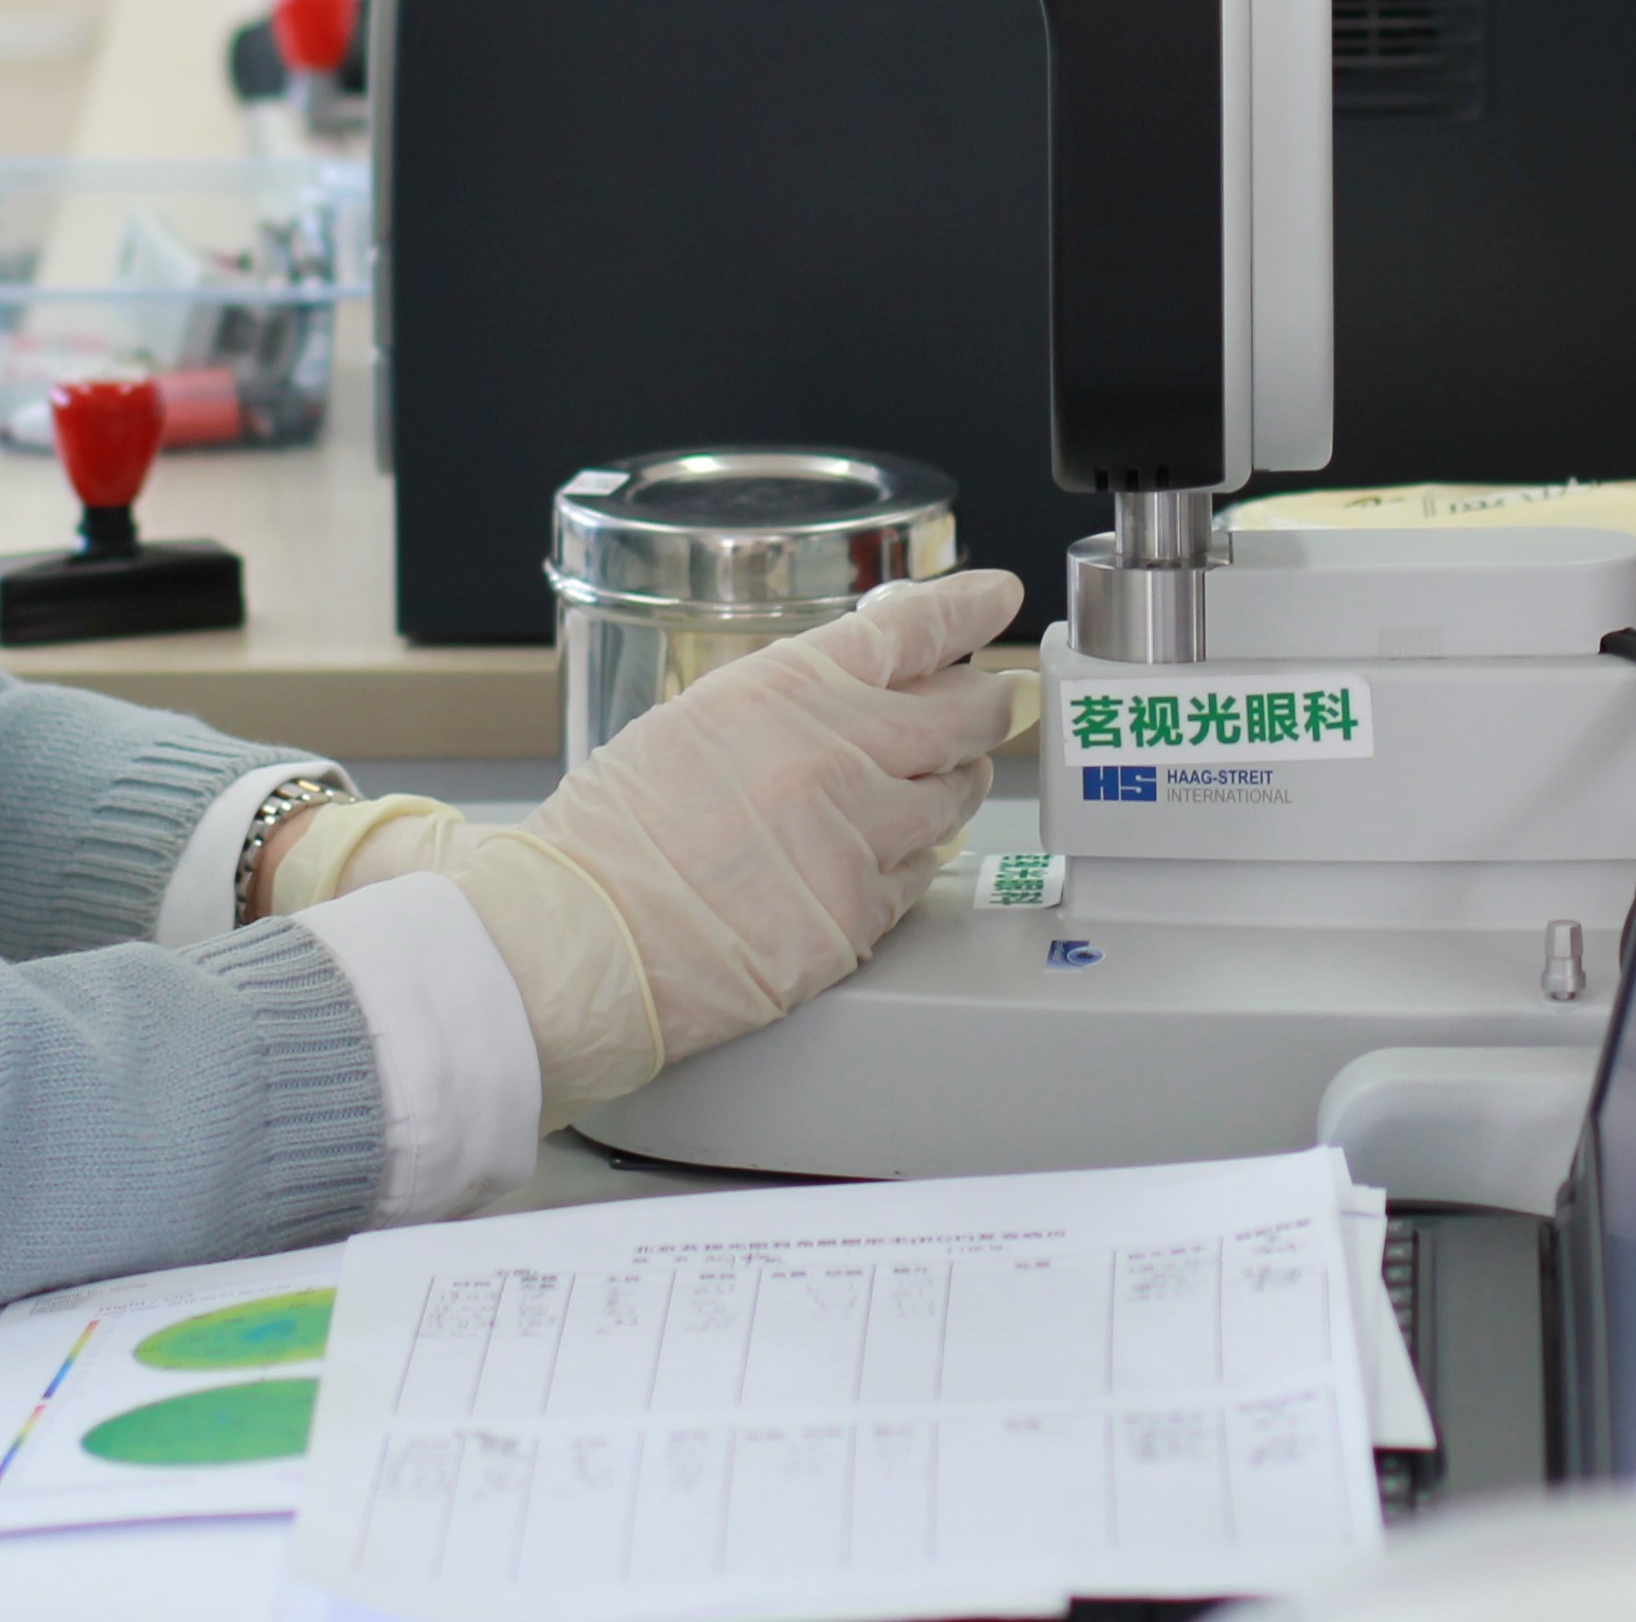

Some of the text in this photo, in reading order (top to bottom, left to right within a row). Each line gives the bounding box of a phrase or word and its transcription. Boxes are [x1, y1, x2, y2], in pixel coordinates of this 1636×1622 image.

[1070, 688, 1359, 749] 茗视光眼科
[1167, 769, 1274, 785] HAAG-STREIT
[1167, 788, 1293, 804] INTERNATIONAL
